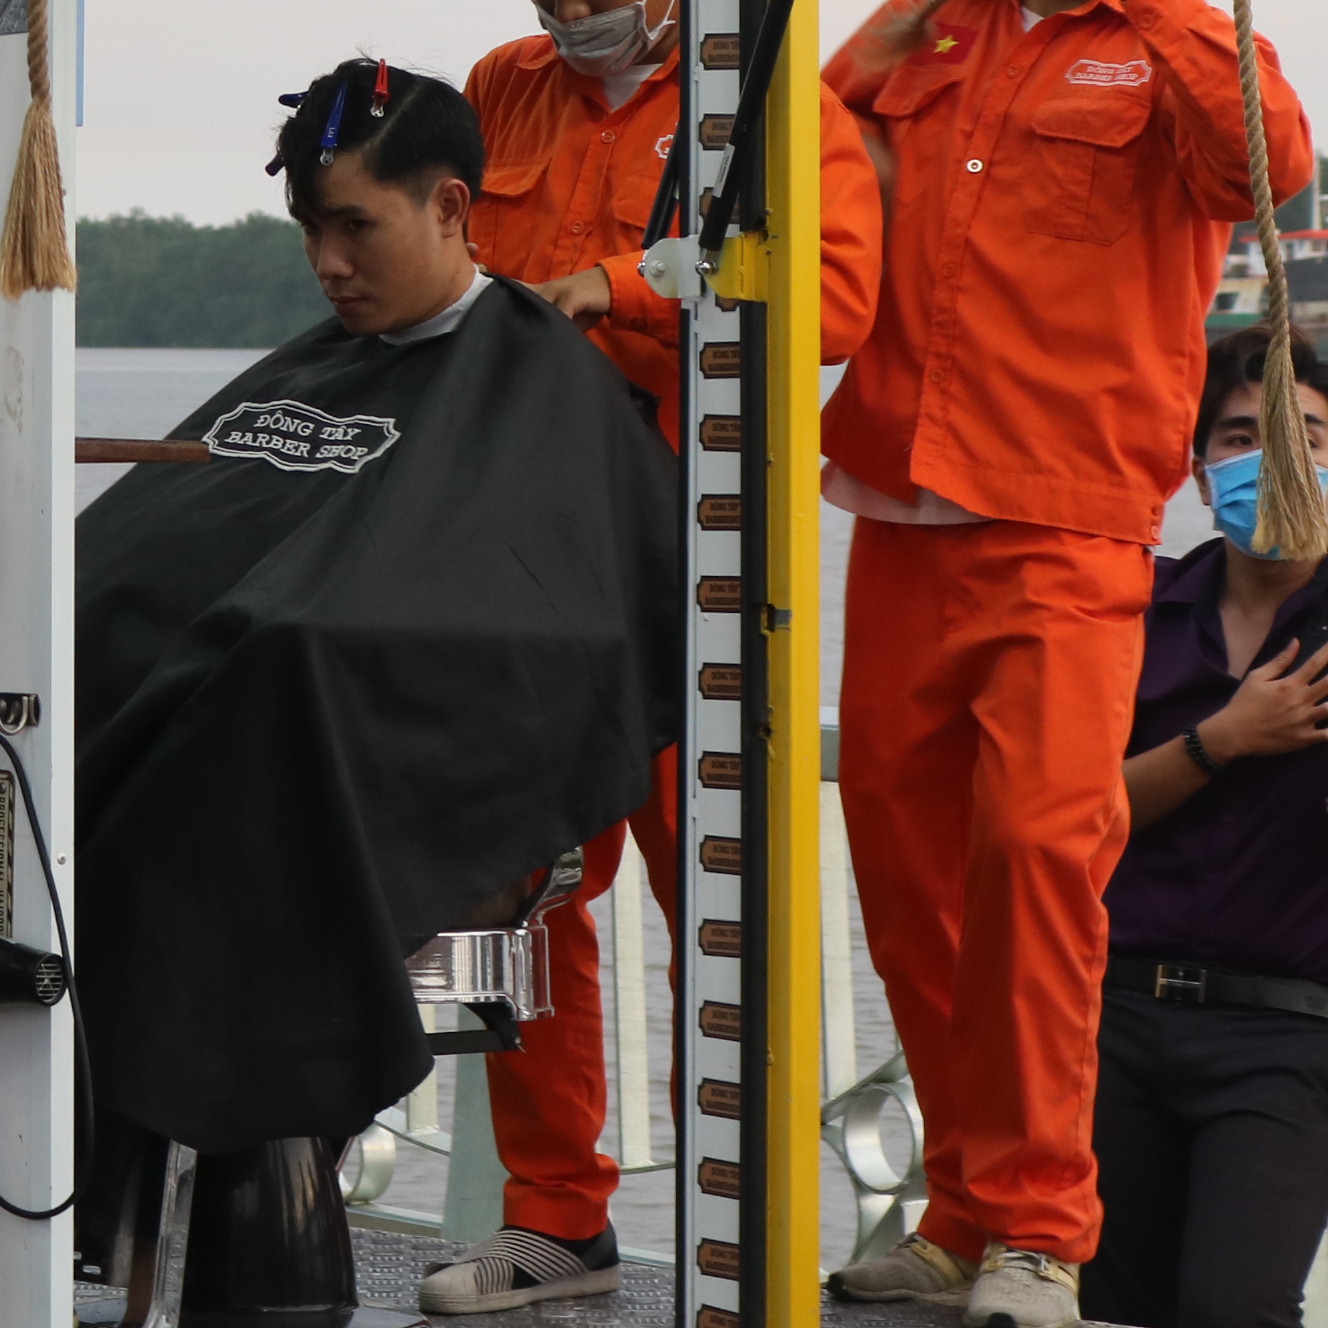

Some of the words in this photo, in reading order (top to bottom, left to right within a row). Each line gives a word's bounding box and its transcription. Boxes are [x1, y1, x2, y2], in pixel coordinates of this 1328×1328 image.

[253, 410, 315, 437] ĐÔNG
[224, 431, 312, 458] BARBER
[315, 444, 370, 461] SHOP
